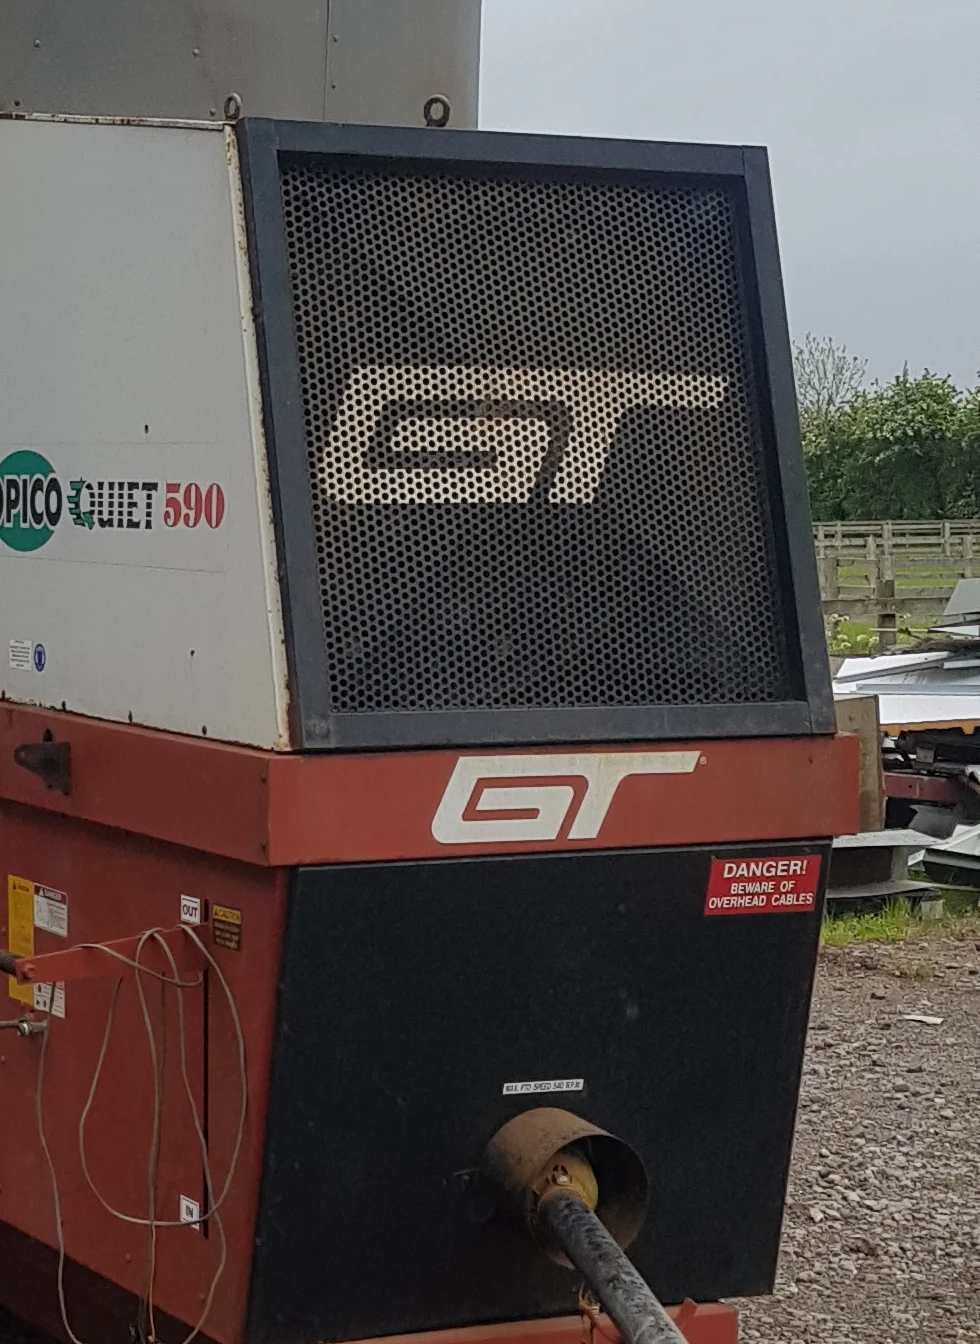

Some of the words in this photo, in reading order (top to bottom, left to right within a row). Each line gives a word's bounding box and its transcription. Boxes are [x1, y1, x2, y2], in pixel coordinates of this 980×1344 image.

[317, 364, 731, 505] GT
[67, 477, 159, 531] QUIET
[163, 481, 226, 529] 590
[431, 750, 702, 844] GT
[723, 859, 808, 878] DANGER!
[730, 881, 776, 894] BEWARE
[780, 880, 796, 892] OF
[708, 894, 767, 909] OVERHEAD
[771, 892, 814, 906] CABLES
[182, 903, 198, 918] OUT
[185, 1204, 194, 1219] IN
